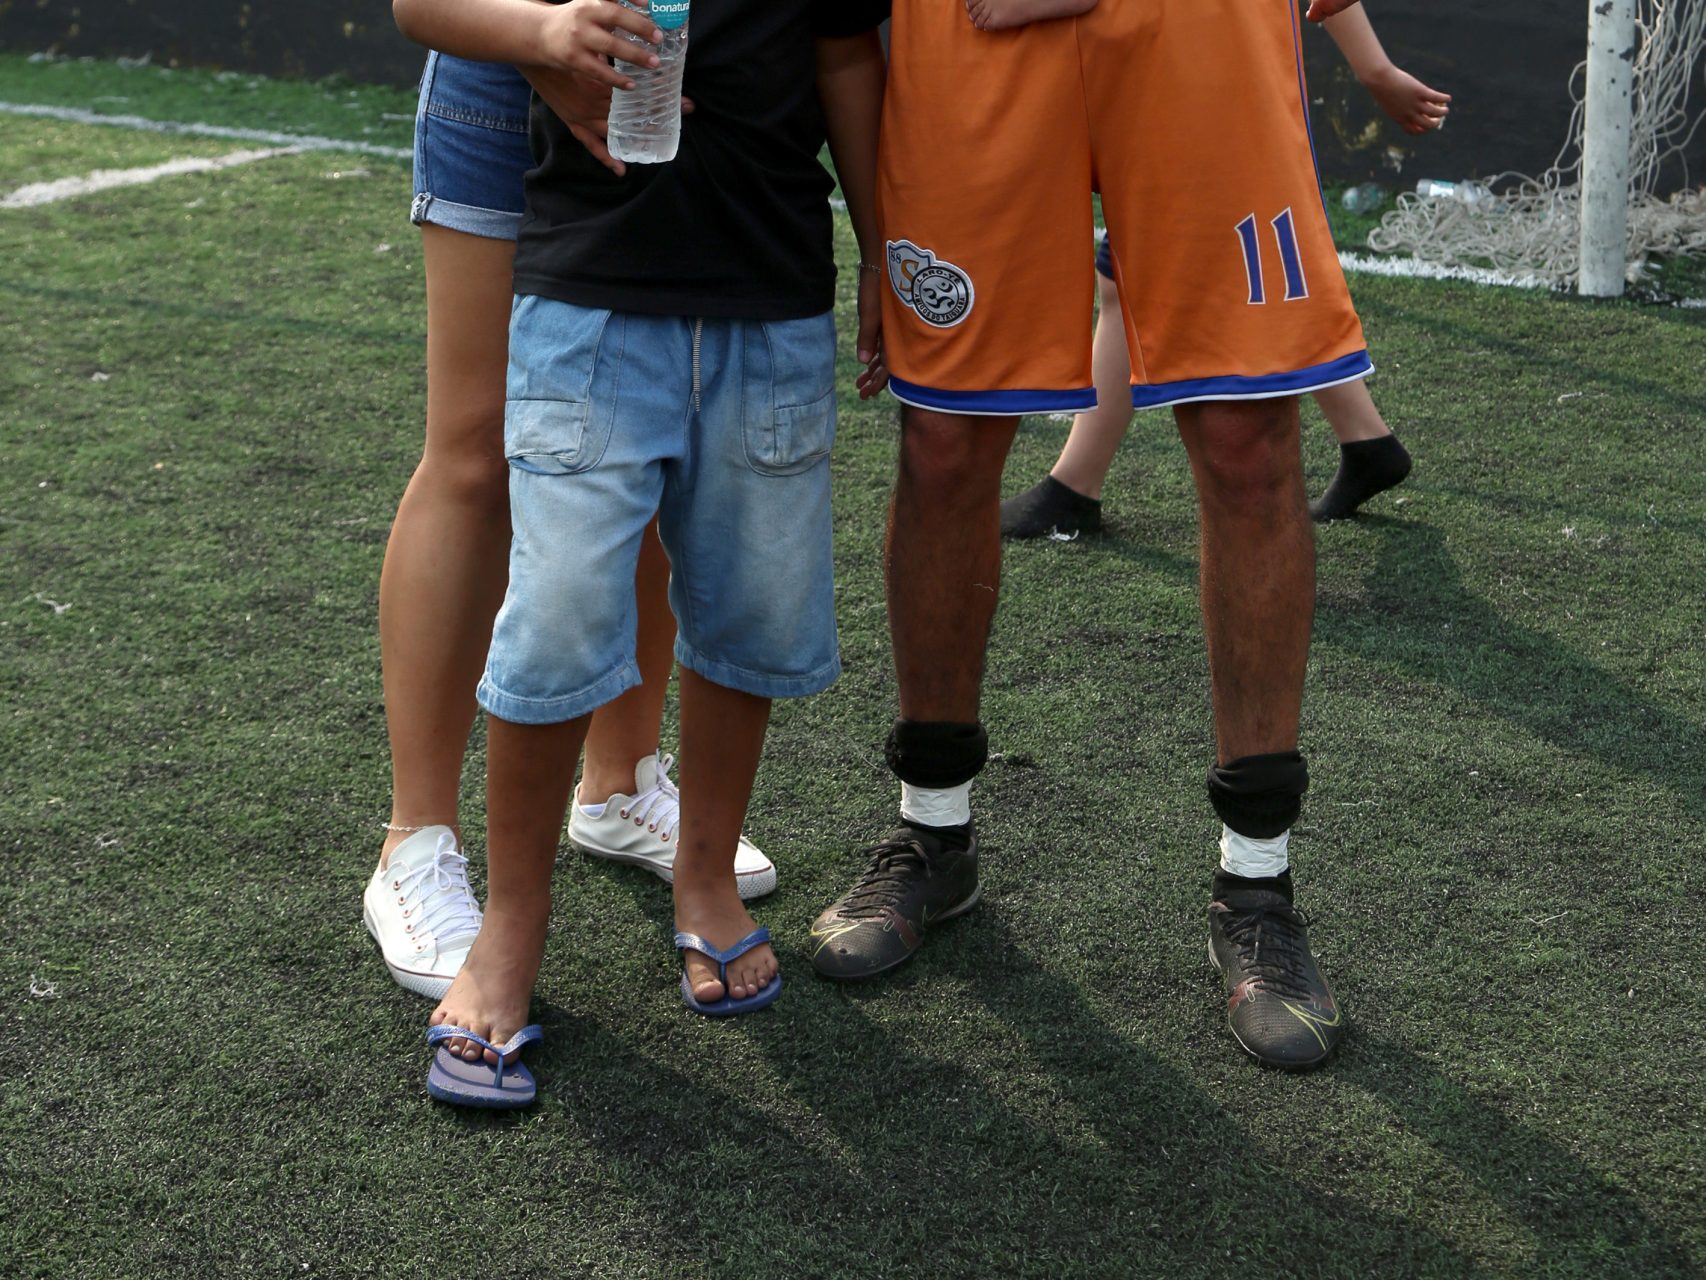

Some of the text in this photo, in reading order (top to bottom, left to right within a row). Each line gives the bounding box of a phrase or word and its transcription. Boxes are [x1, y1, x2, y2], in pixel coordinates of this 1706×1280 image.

[890, 251, 902, 264] 88
[1234, 205, 1310, 304] 11
[898, 259, 919, 292] S
[914, 293, 930, 319] AMIGOS
